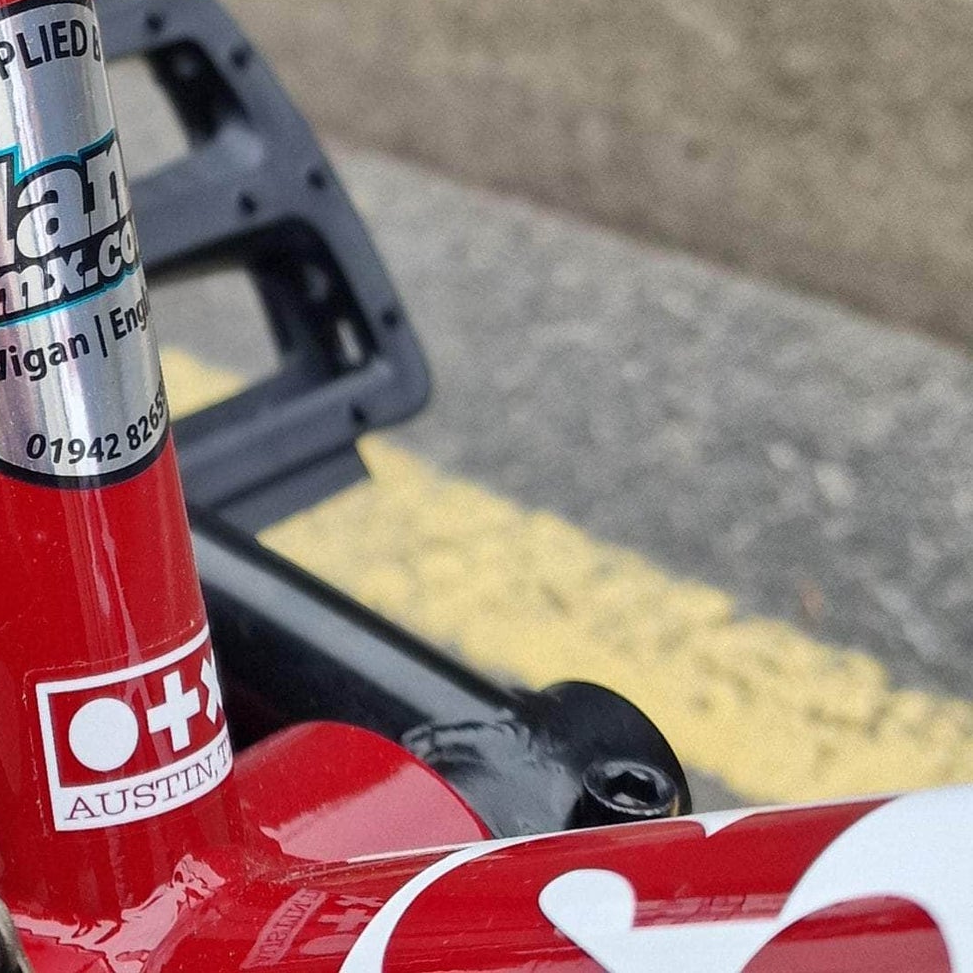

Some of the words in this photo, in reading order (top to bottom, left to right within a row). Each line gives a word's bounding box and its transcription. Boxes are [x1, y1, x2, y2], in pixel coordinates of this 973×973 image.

[108, 284, 151, 341] Engl
[26, 433, 122, 465] 01942
[64, 753, 219, 822] AUSTIN,
